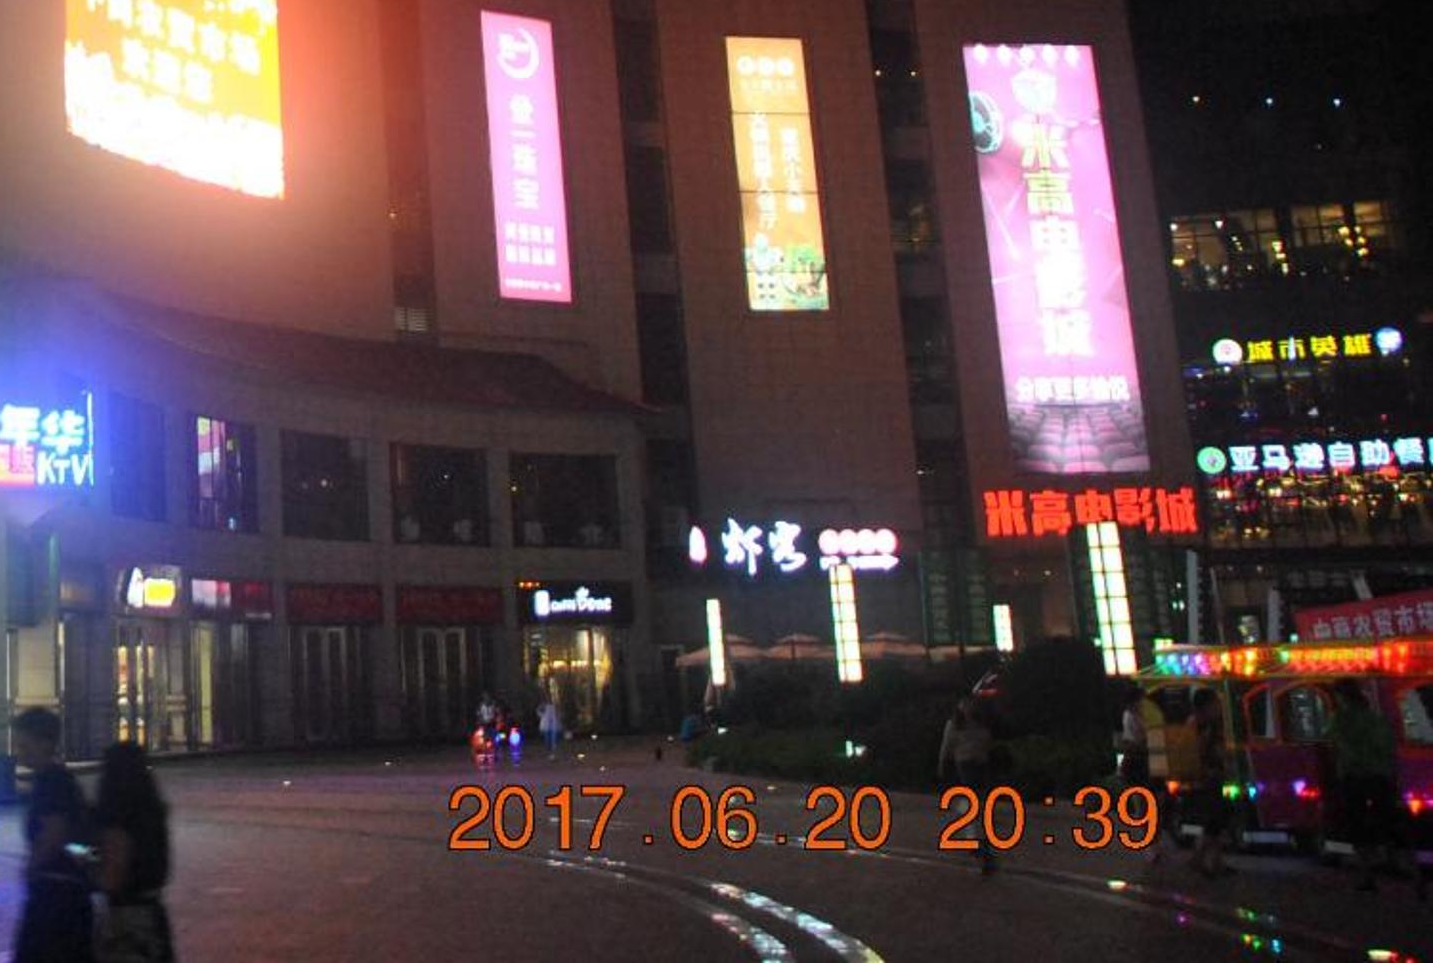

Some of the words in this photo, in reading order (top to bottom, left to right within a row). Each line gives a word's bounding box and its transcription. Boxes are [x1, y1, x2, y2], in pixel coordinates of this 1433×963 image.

[1247, 334, 1373, 362] 城市英雄
[36, 451, 90, 486] KTV
[1228, 436, 1433, 473] 亚马逊自助餐
[983, 487, 1198, 538] 米高电影城
